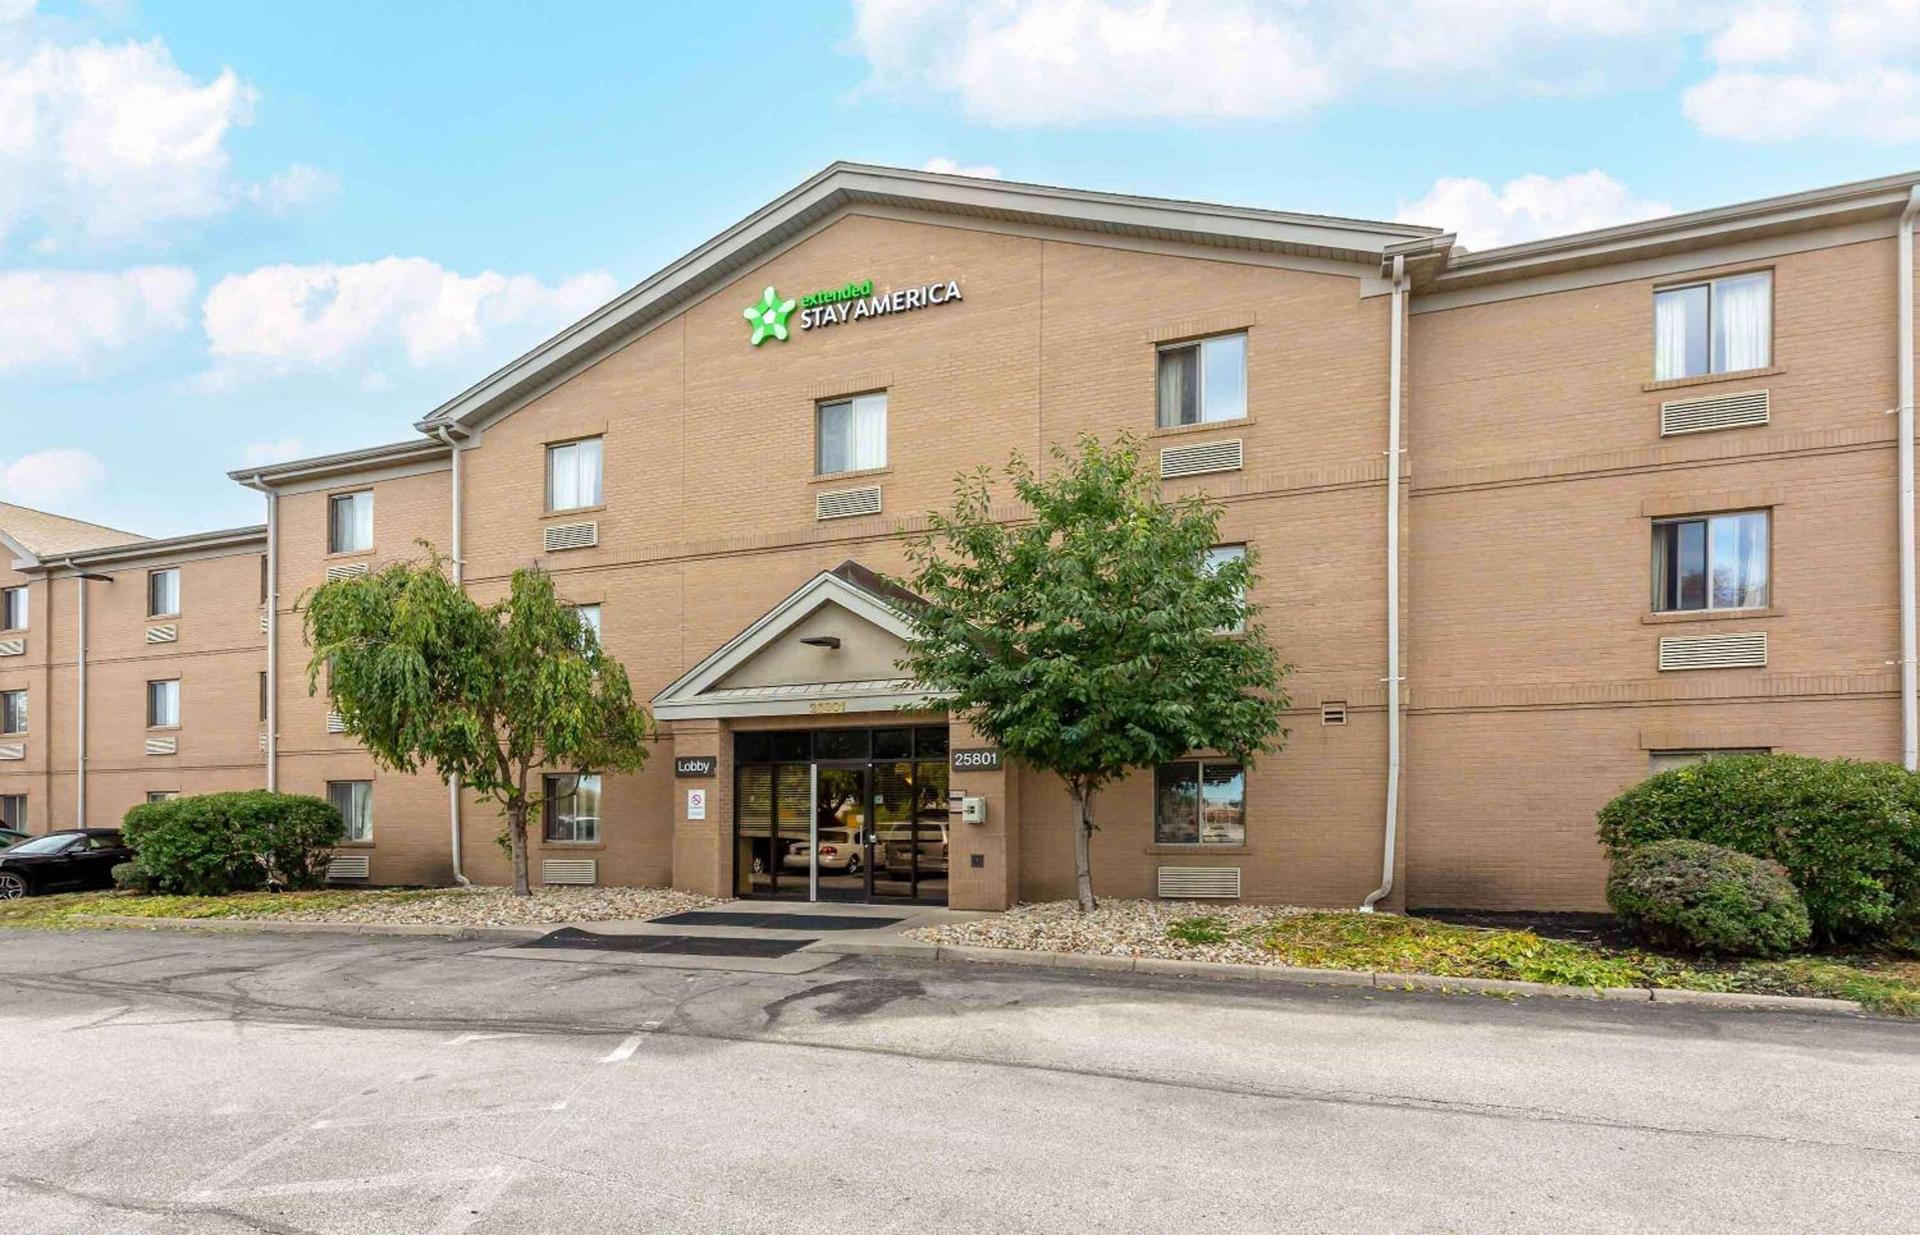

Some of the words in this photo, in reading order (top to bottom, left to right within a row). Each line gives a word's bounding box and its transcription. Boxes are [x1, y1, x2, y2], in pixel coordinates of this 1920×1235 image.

[801, 280, 873, 307] extended
[954, 752, 997, 766] 25801
[678, 760, 710, 774] Lobby
